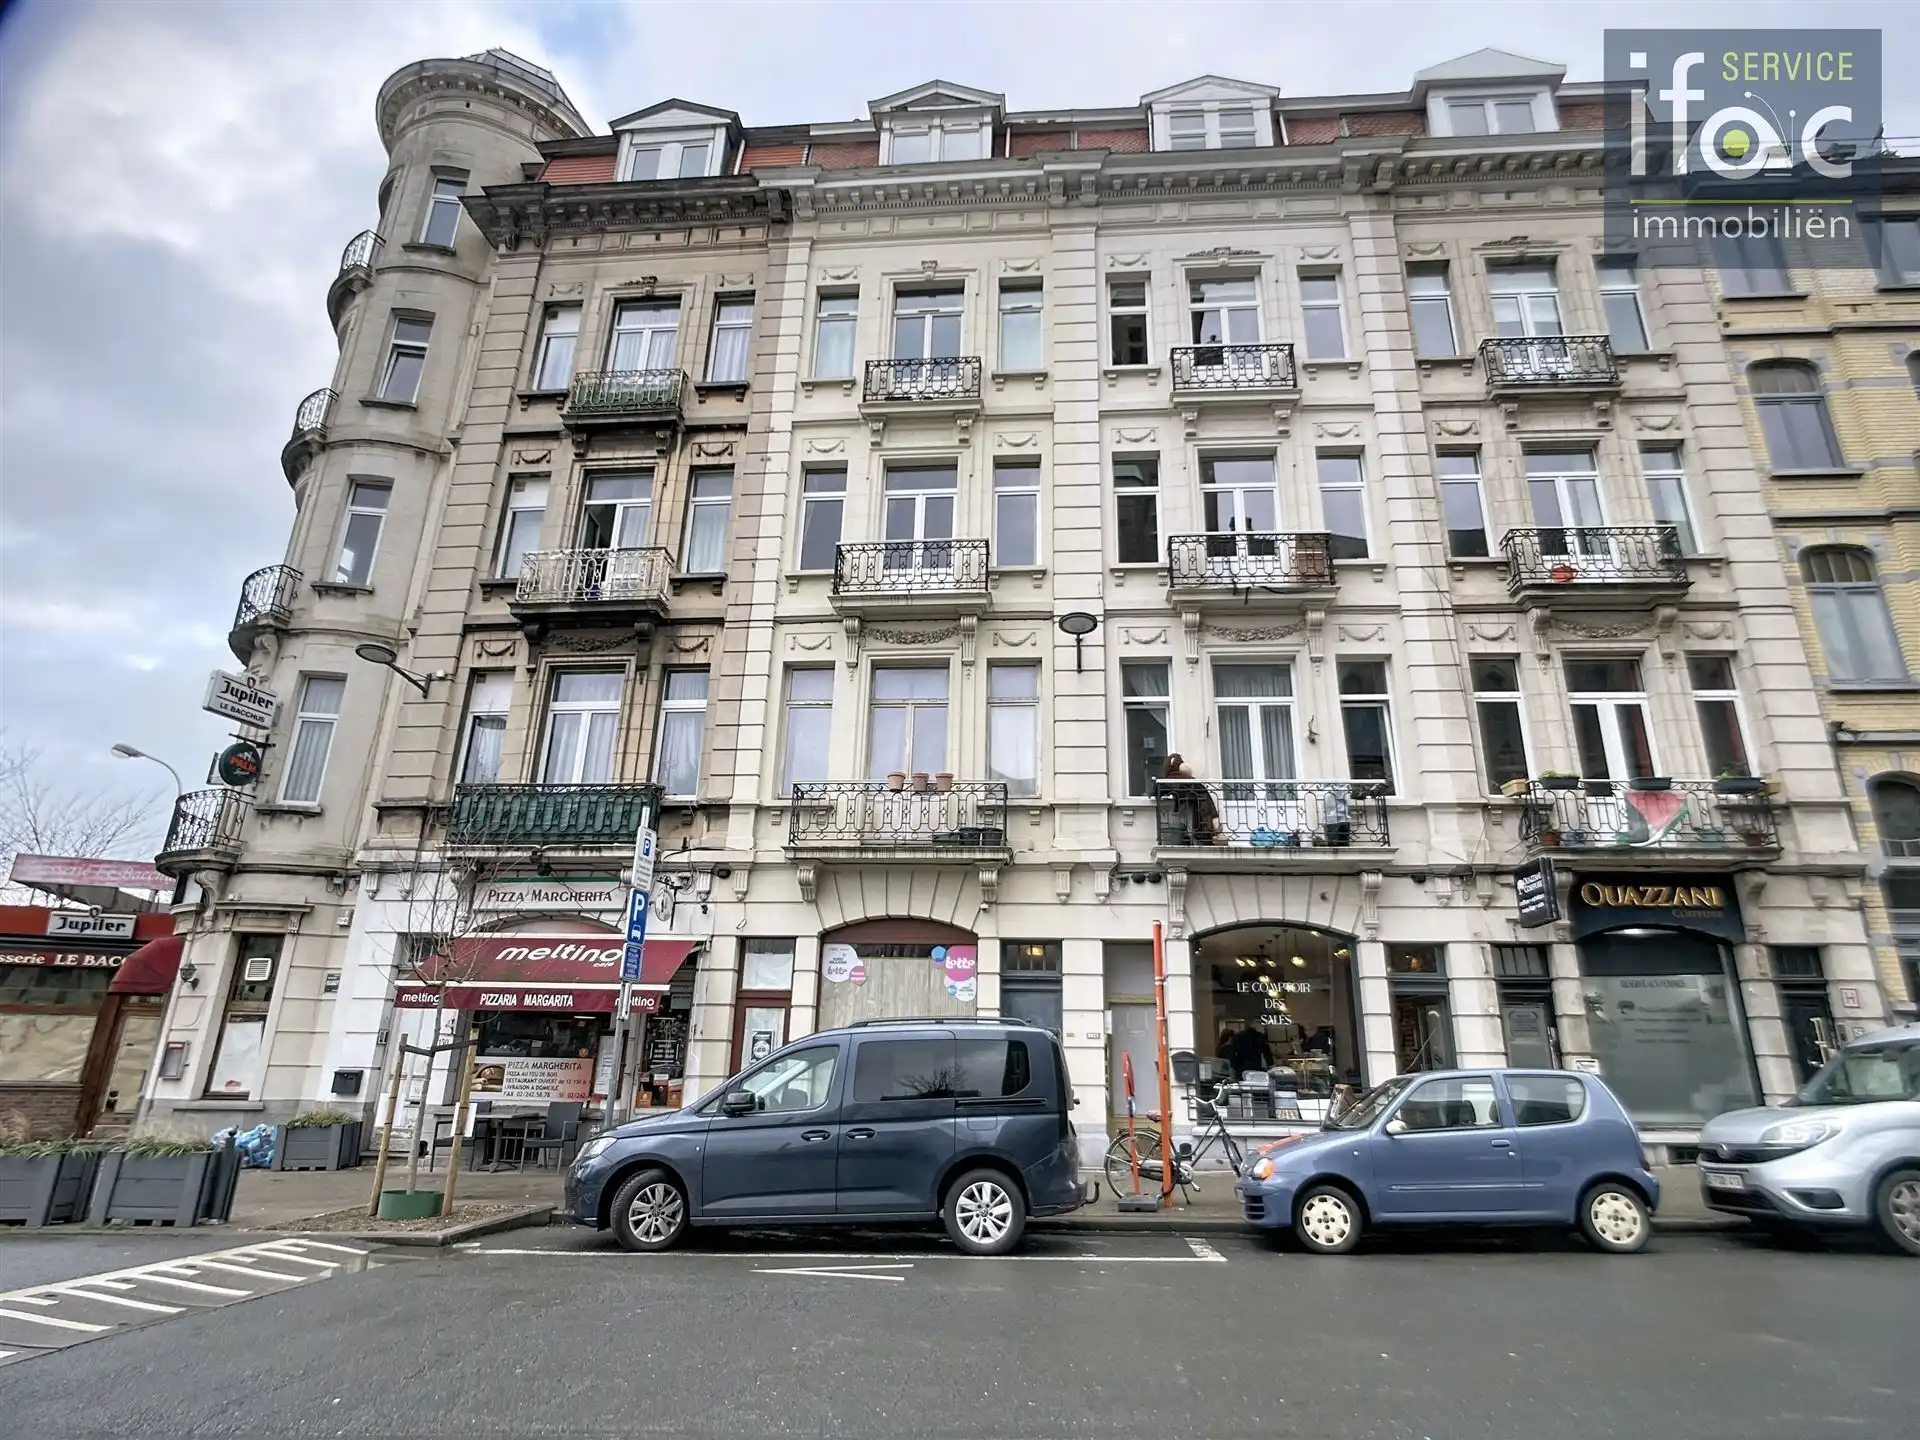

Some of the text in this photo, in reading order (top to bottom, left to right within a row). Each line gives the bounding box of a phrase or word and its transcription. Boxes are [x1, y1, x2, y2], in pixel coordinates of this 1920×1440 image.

[221, 680, 274, 710] Jupiler
[220, 702, 265, 723] LE BACCHUS
[488, 888, 612, 902] PIZZA MARGHERITA
[1581, 882, 1724, 907] OUAZZANI
[633, 893, 646, 921] P
[56, 917, 126, 933] Jupiler
[54, 953, 78, 965] LE
[496, 943, 623, 963] meltino
[1236, 981, 1312, 993] LE COMPTOIR
[480, 994, 573, 1007] PIZZARIA MARGARITA
[1264, 998, 1285, 1009] DES
[508, 1061, 582, 1071] PIZZA MARGHERITA
